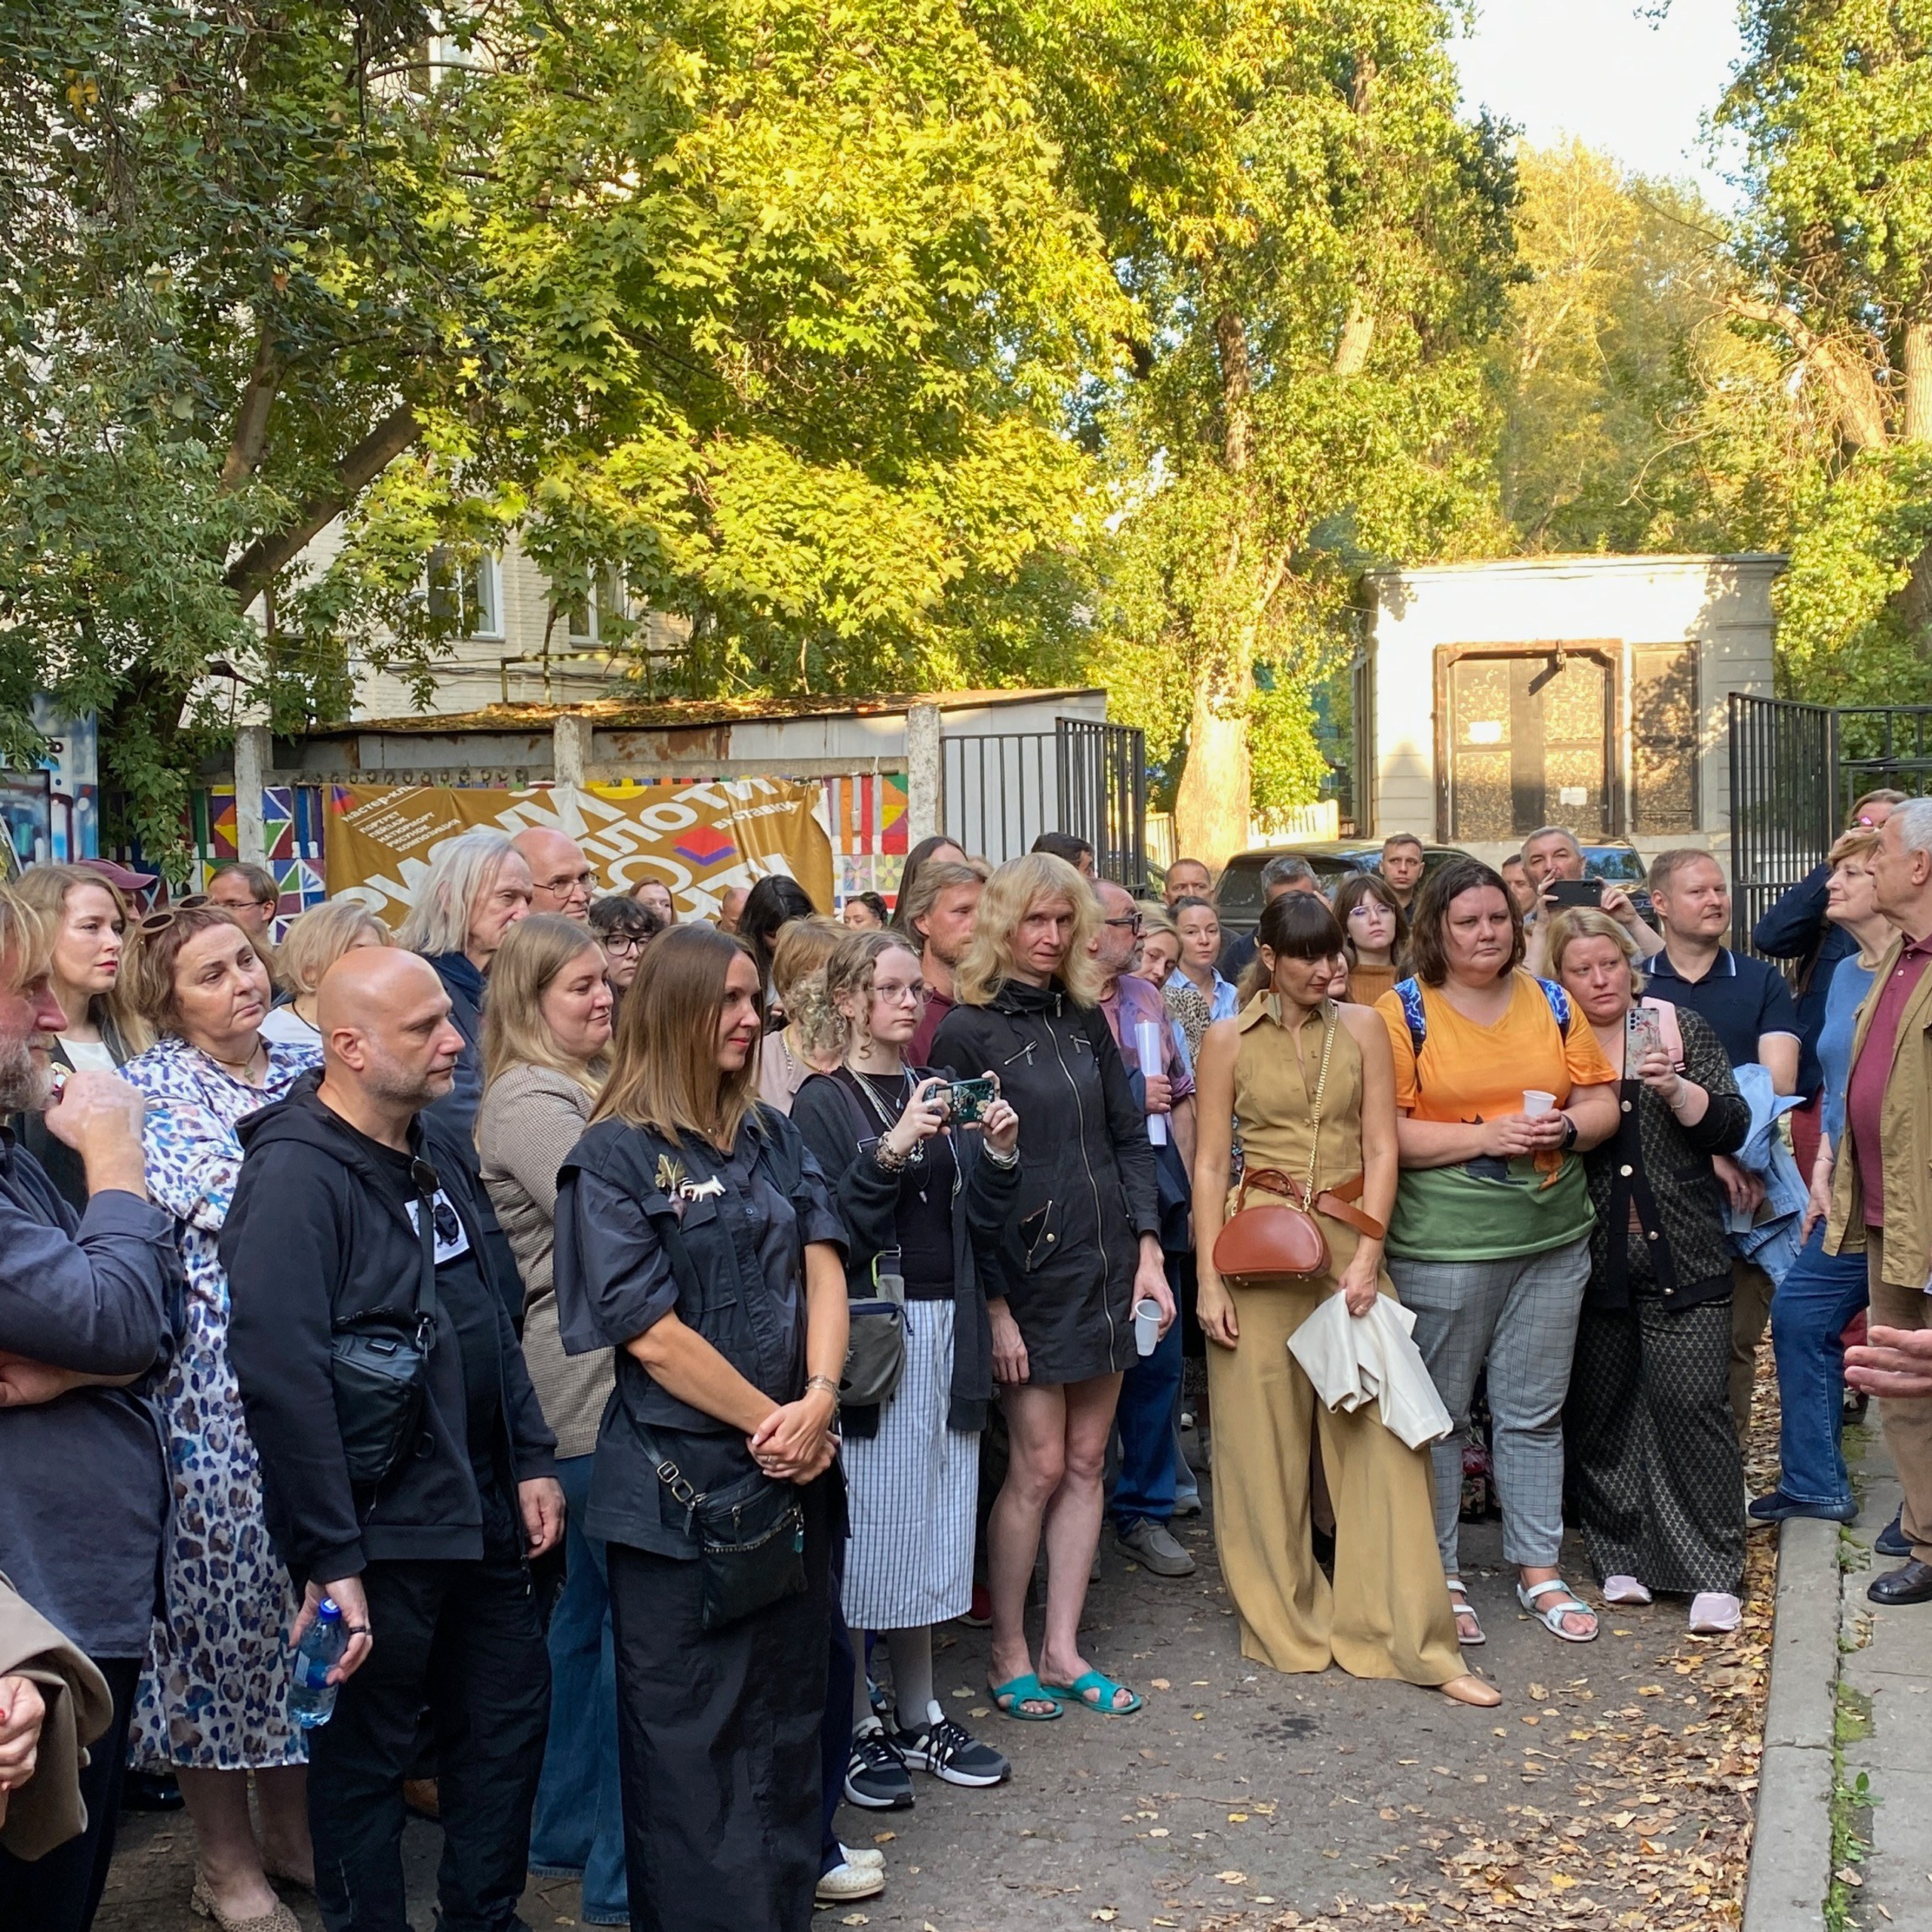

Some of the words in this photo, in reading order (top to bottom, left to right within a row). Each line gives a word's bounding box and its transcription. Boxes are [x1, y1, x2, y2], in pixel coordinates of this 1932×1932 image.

[358, 811, 400, 833] ПОРТРЕТ
[368, 817, 408, 838] ПЕЙЗАЖ
[377, 811, 435, 843] НАТЮРМОРТ
[386, 824, 431, 848] РИСУНОК
[395, 818, 461, 852] КОМПОЗИЦИЯ
